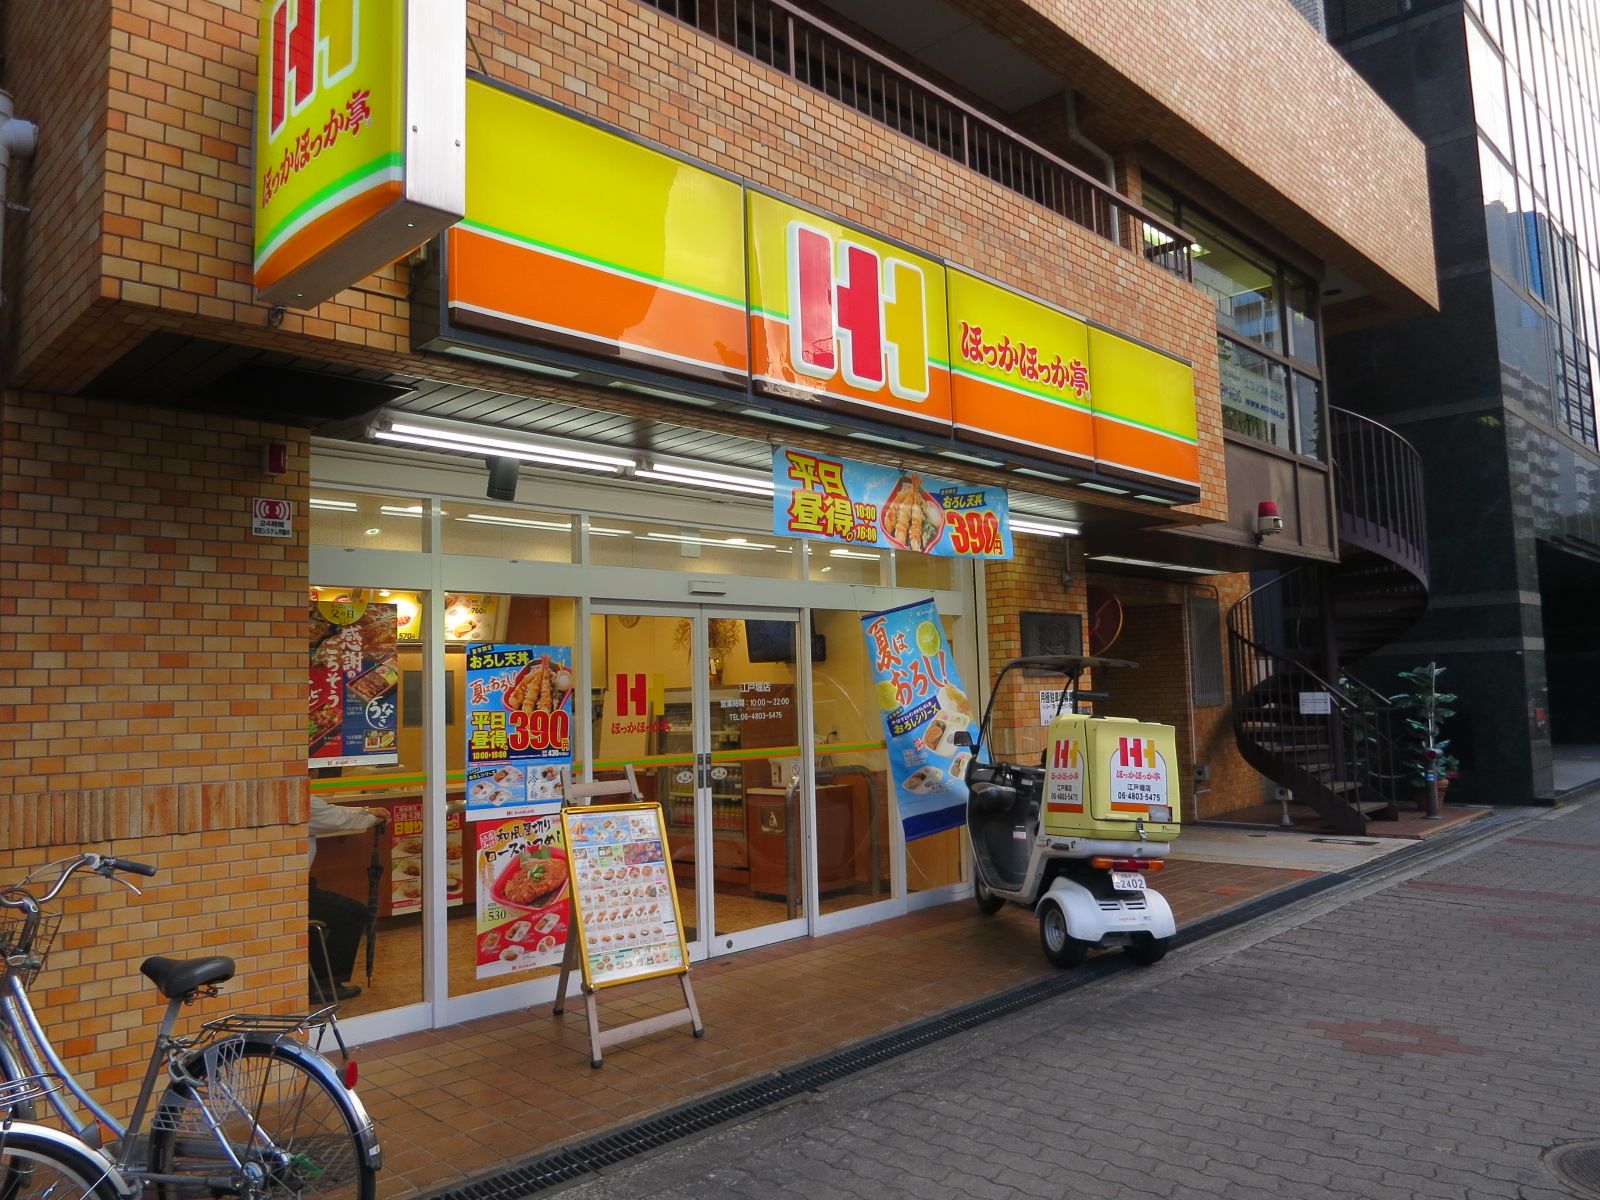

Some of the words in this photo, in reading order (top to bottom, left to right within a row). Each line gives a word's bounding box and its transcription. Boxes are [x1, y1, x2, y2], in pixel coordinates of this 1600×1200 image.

[262, 88, 371, 209] ほっかほっか亭
[959, 320, 1090, 397] ほっかほっか亭
[785, 451, 849, 497] 平日
[943, 494, 984, 508] おろし天丼
[854, 503, 877, 522] 10:00
[855, 525, 877, 542] 16:00
[330, 609, 355, 619] 父の日
[341, 625, 363, 679] 感謝の
[867, 617, 910, 673] 夏は
[469, 652, 530, 669] おろし天丼
[325, 638, 343, 709] ごちそう
[739, 682, 772, 692] 江戸堀店
[369, 700, 395, 728] うなぎ
[471, 711, 507, 730] 平日
[893, 704, 940, 736] おろしシリーズ
[1116, 770, 1161, 781] ほっかほっか亭
[1127, 783, 1151, 792] 江戸堀店
[496, 819, 551, 843] 和風厚切り
[485, 830, 562, 863] ロースかつめし
[1120, 878, 1145, 889] 2402
[488, 910, 507, 922] 530
